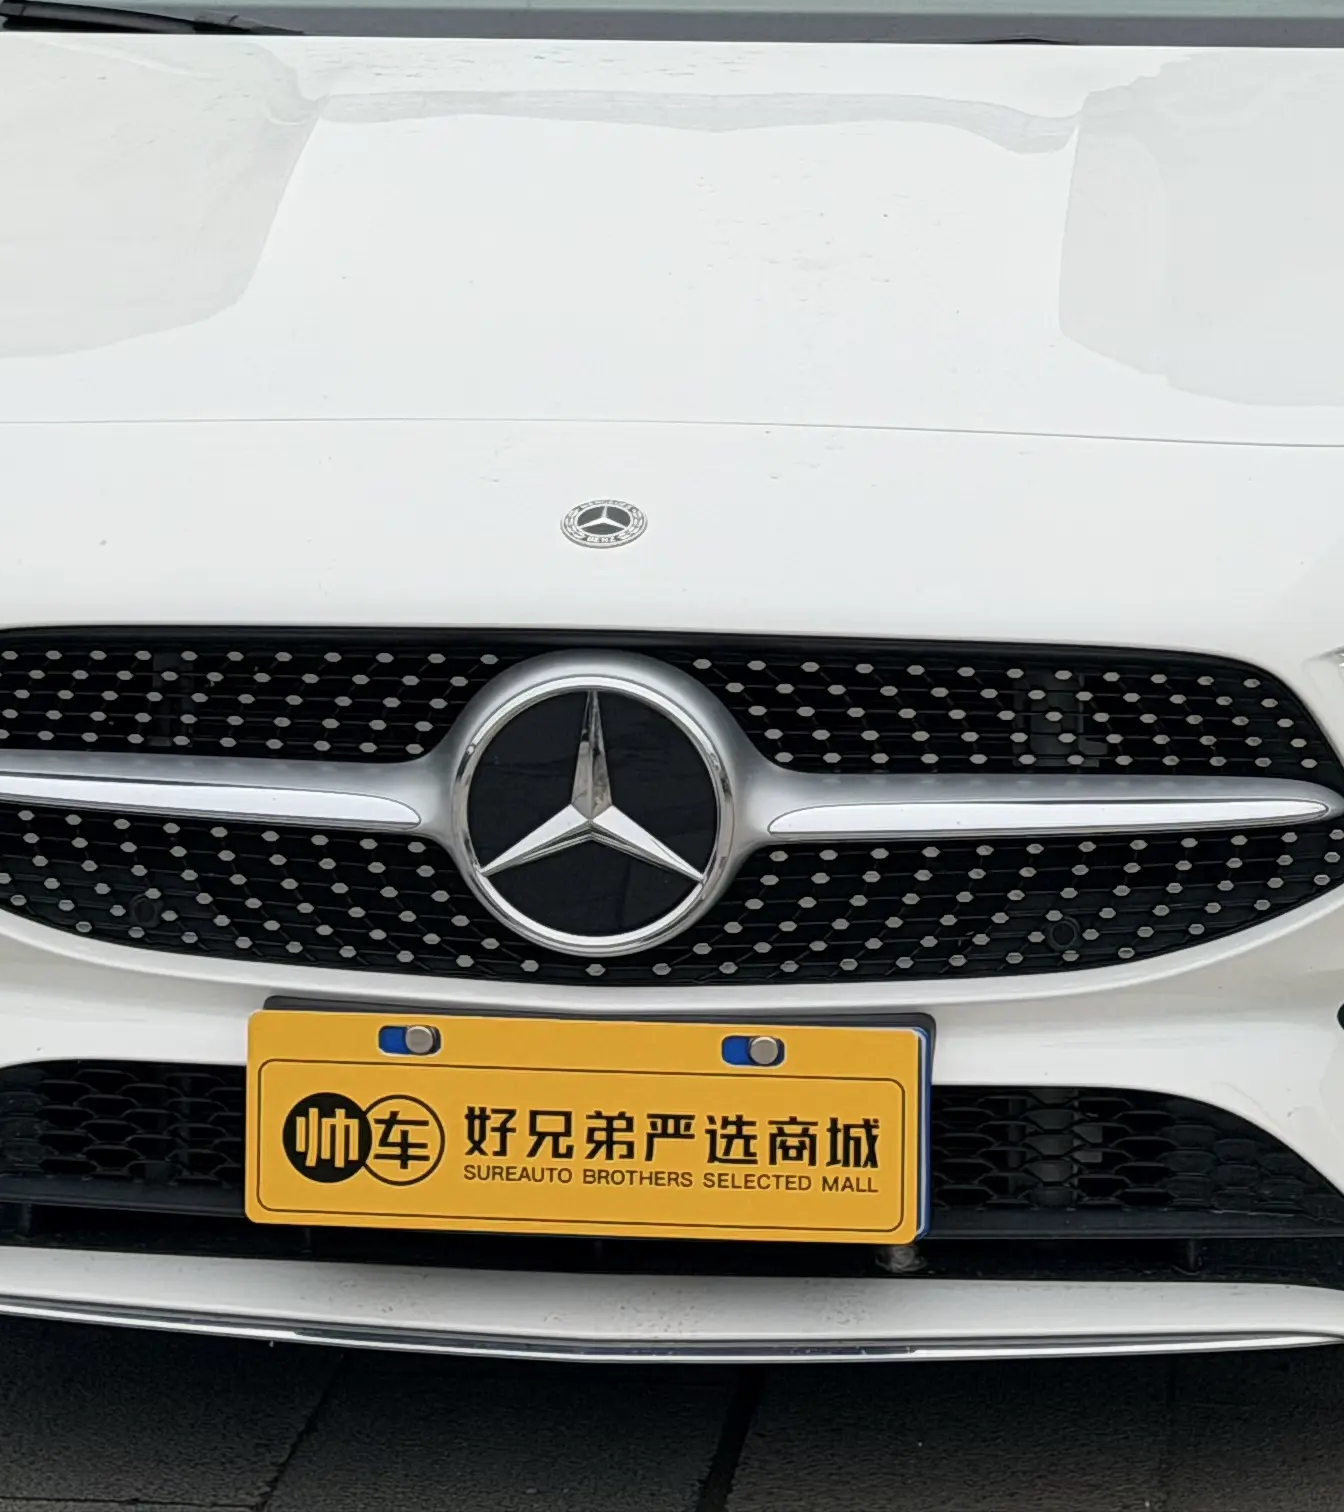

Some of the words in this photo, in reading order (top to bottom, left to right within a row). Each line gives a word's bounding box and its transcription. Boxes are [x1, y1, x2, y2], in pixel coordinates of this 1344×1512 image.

[464, 1105, 880, 1169] 好兄弟严选商城
[463, 1164, 573, 1184] SUREAUTO
[582, 1168, 694, 1187] BROTHERS
[702, 1172, 813, 1191] SELECTED
[821, 1176, 879, 1194] MALL
